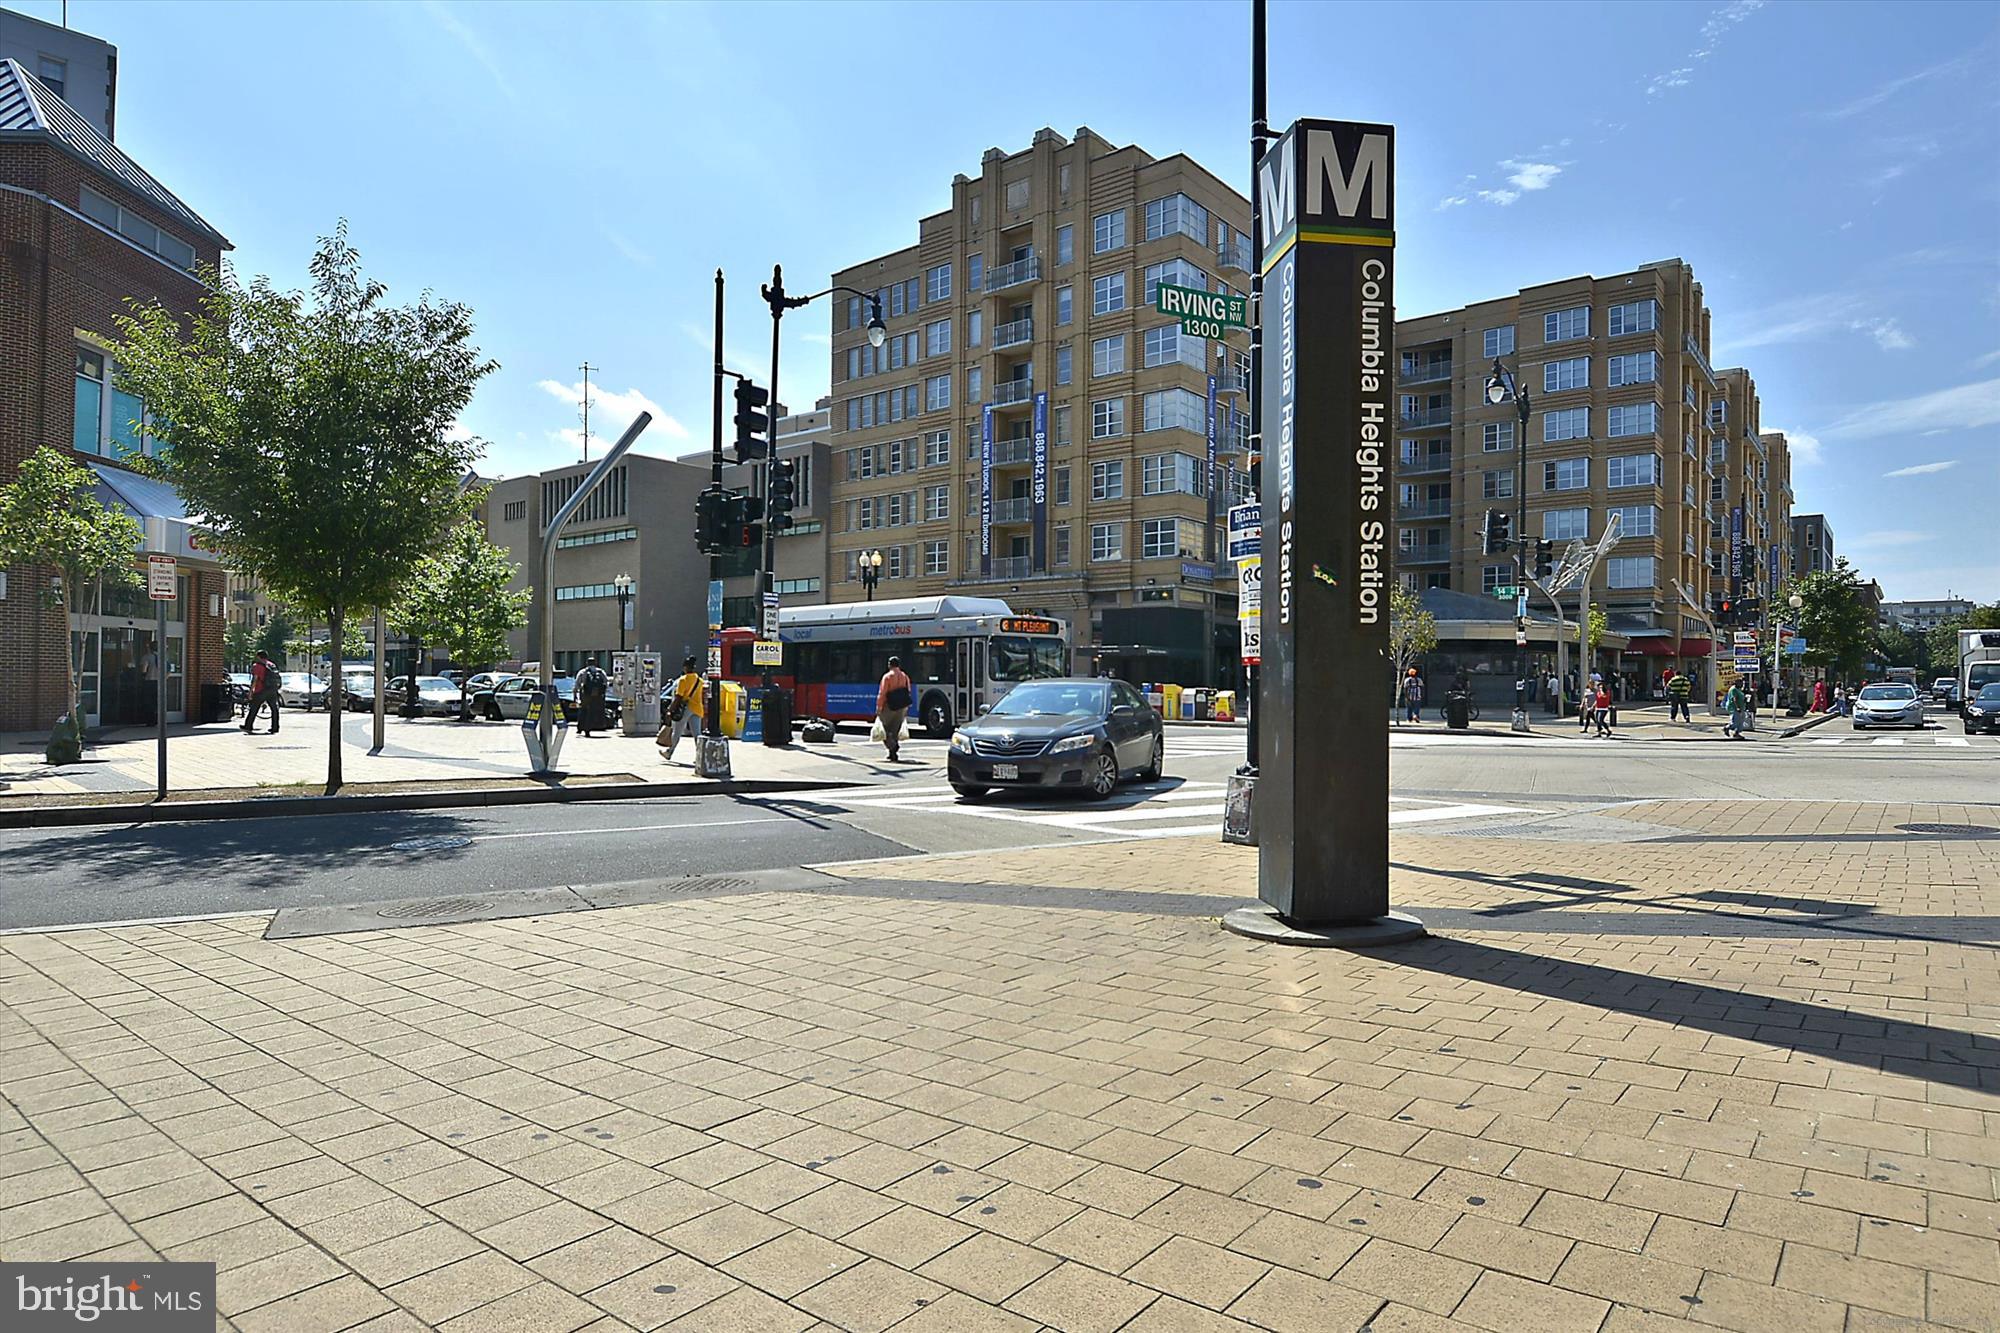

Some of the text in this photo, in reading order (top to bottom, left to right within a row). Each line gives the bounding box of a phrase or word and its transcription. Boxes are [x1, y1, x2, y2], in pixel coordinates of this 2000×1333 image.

[1306, 129, 1388, 219] M
[1260, 134, 1294, 249] M
[1162, 288, 1242, 320] IRVING ST
[1230, 312, 1242, 322] NW
[1184, 320, 1220, 338] 1300
[1208, 440, 1215, 448] A
[1280, 261, 1294, 625] Columbia Heights Station
[1355, 259, 1386, 625] Columbia Heights Station
[1035, 432, 1046, 504] 888.842.1963
[1208, 449, 1216, 471] NEW
[1235, 510, 1260, 524] Brian
[982, 514, 990, 556] BEDROOMS
[1731, 532, 1741, 577] 888.842.1963
[793, 628, 813, 639] local
[870, 623, 913, 636] metrobus
[1023, 621, 1050, 632] PLEASANT
